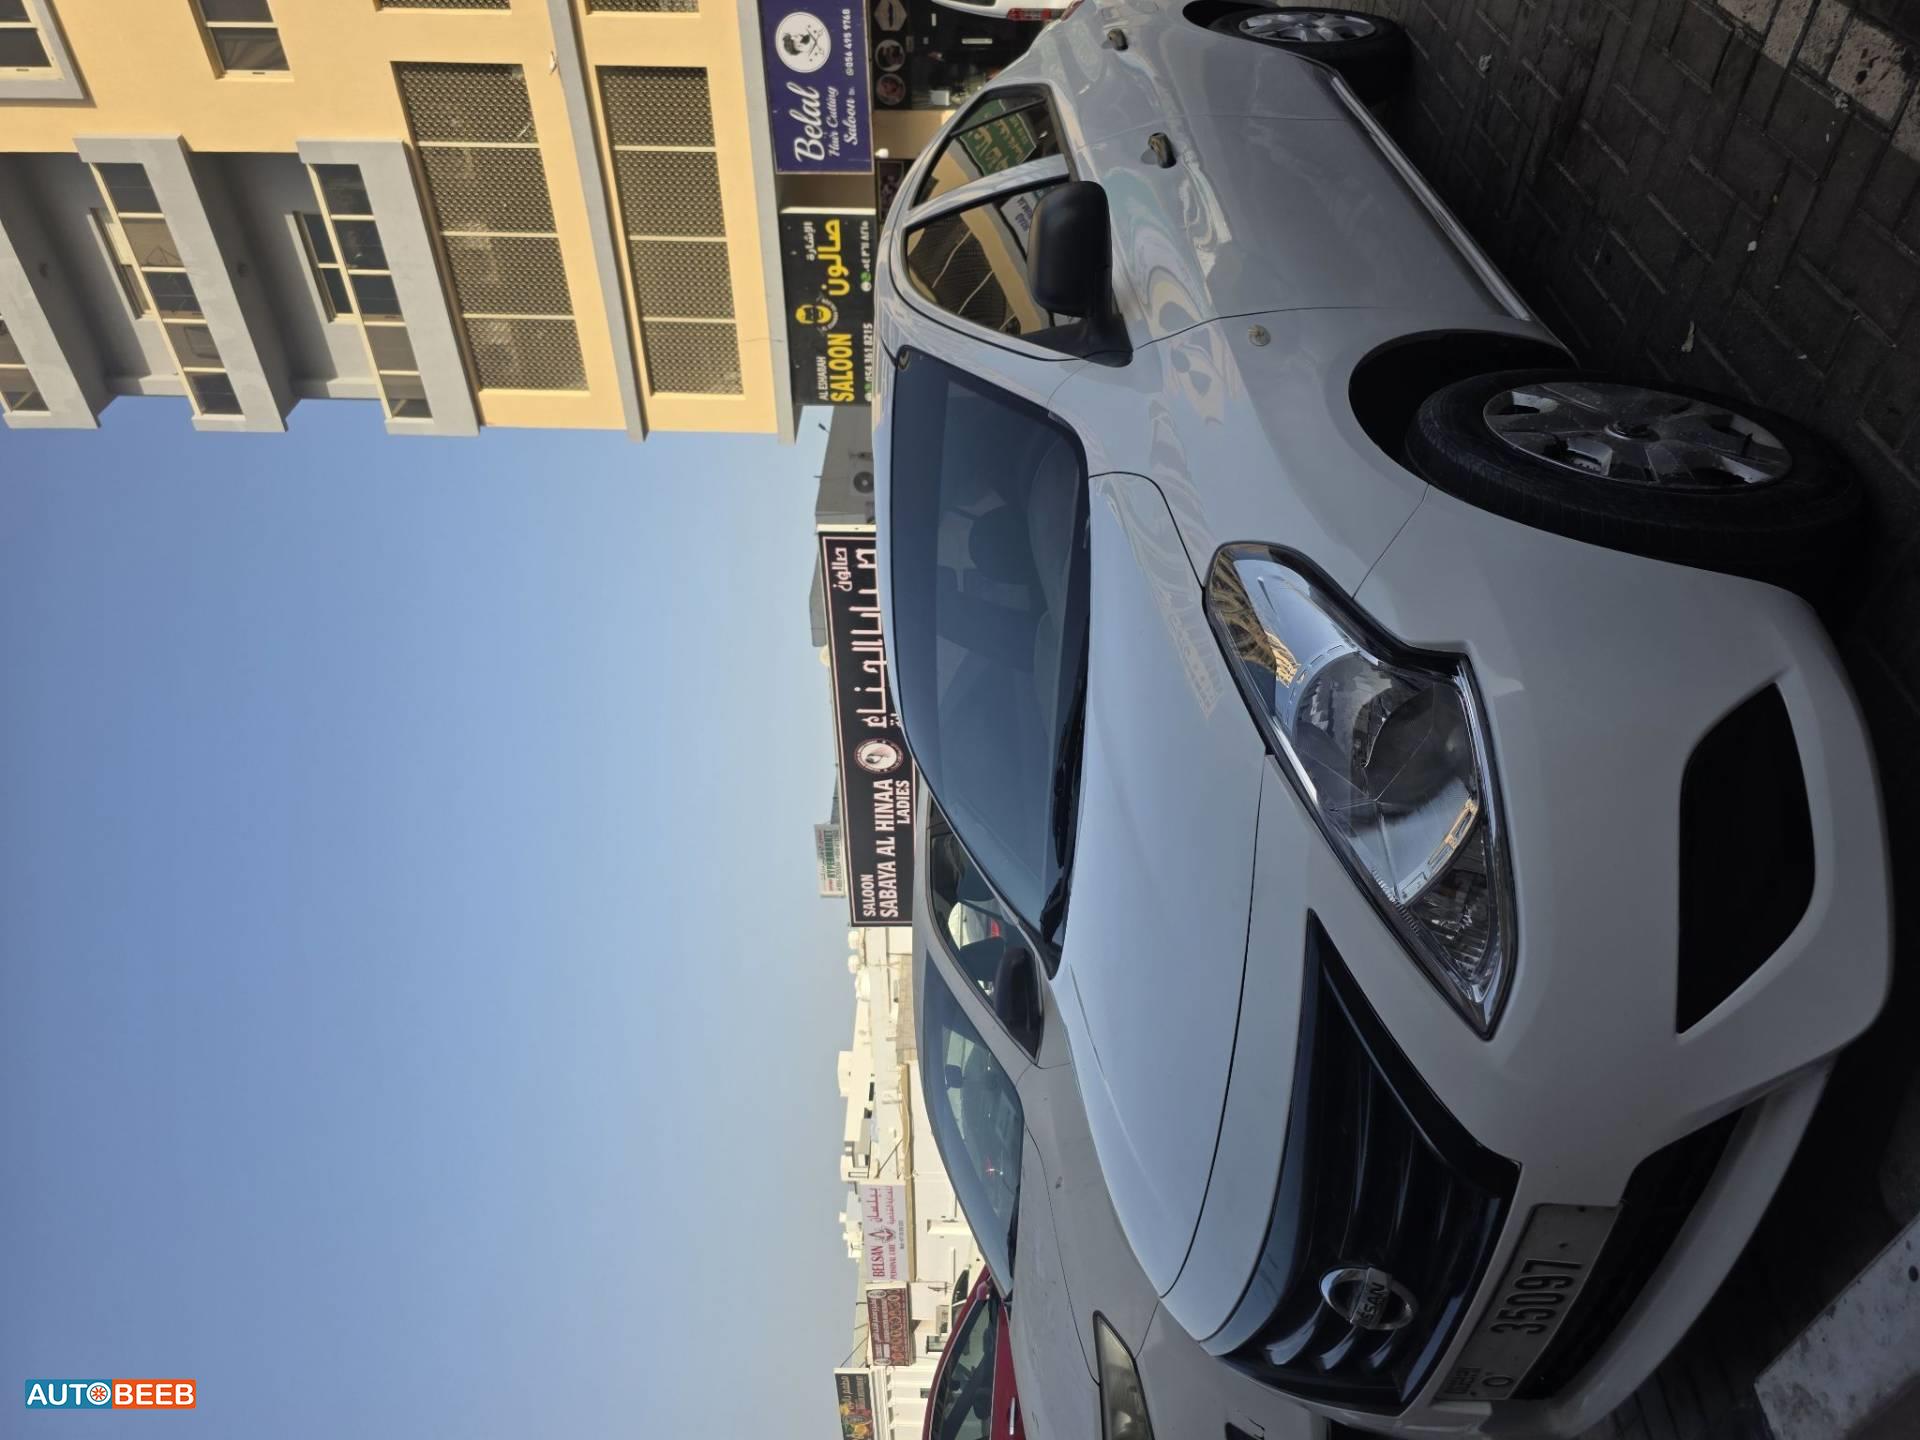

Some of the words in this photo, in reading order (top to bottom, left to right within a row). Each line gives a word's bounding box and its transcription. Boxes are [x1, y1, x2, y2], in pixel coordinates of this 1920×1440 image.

[787, 81, 825, 162] Belal
[826, 86, 839, 128] Cutting
[842, 98, 858, 146] Saloon
[828, 131, 840, 156] Hair
[803, 222, 817, 261] الإشارة
[817, 219, 850, 295] صالون
[827, 334, 855, 401] SALOON
[819, 391, 829, 400] AL
[831, 547, 853, 592] صالون
[873, 779, 895, 832] HINAA
[895, 780, 911, 824] LADIES
[876, 836, 896, 857] AL
[861, 874, 876, 917] SALOON
[877, 860, 898, 918] SABAYA
[871, 1245, 885, 1277] BELSAN
[1488, 1258, 1583, 1335] 35097
